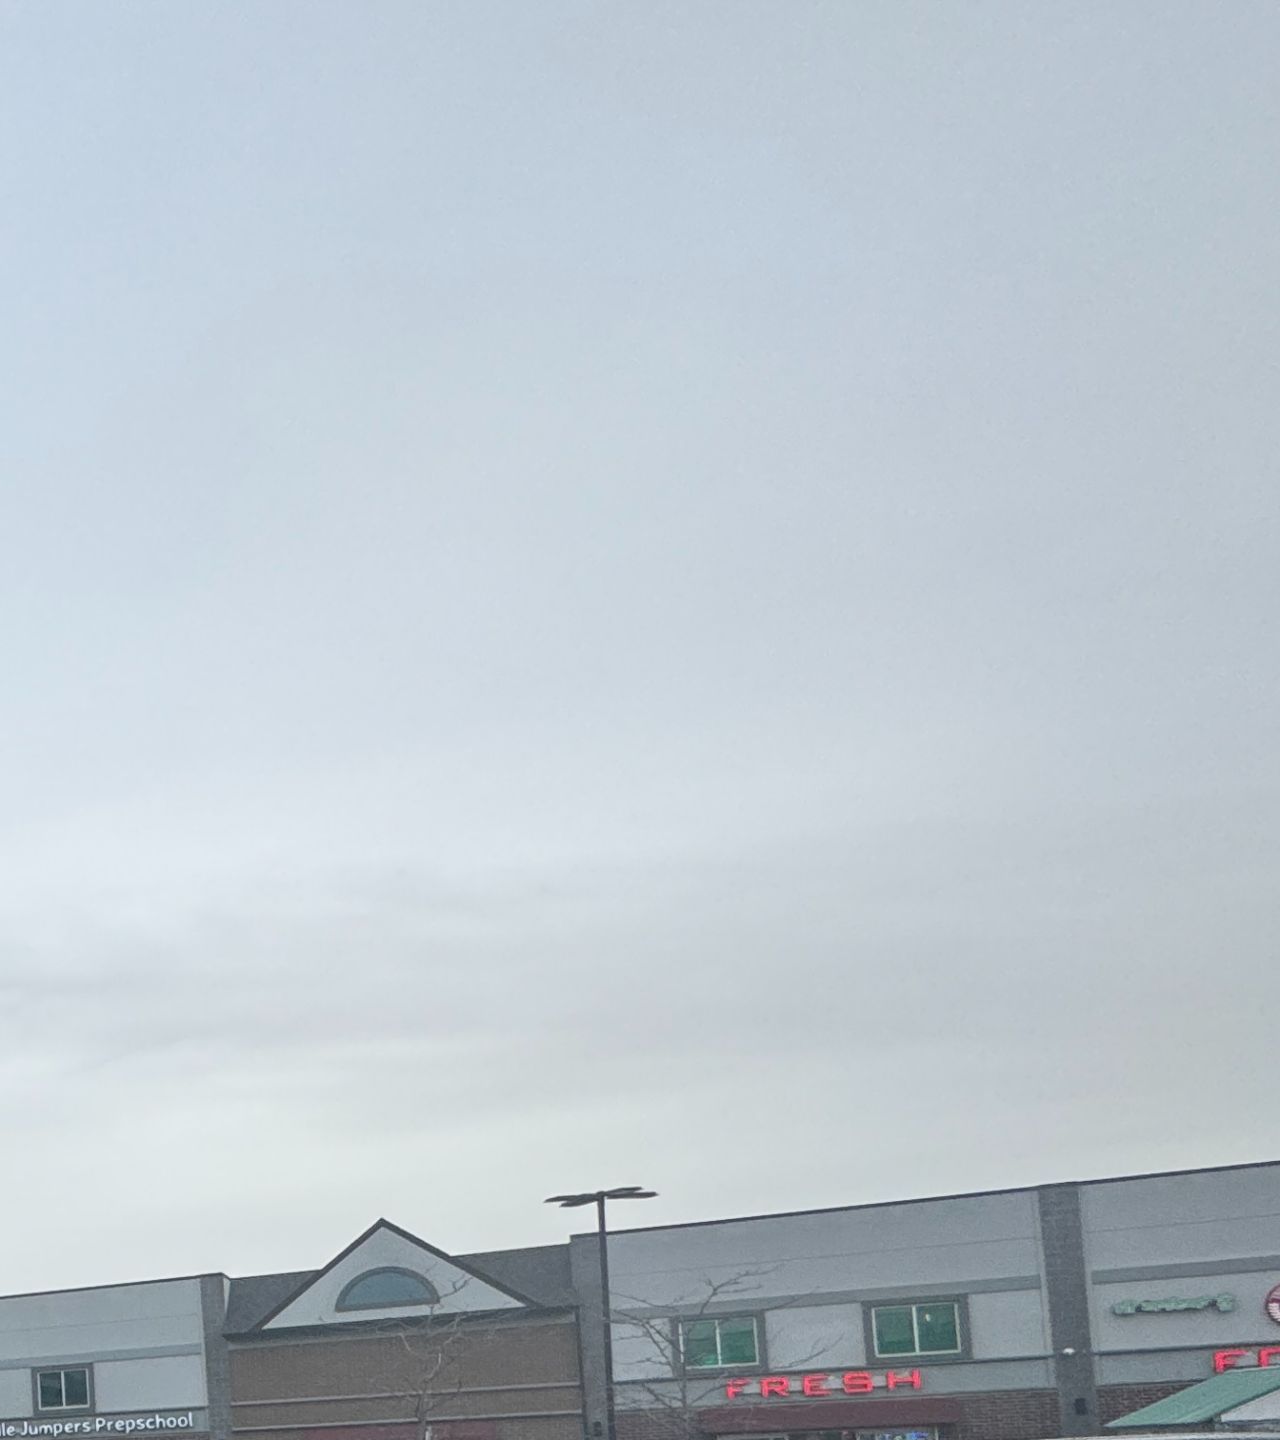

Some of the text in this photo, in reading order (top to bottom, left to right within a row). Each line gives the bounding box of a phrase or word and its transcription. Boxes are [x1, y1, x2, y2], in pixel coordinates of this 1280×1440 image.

[726, 1368, 922, 1399] FRESH
[20, 1421, 91, 1437] Jumpers
[95, 1411, 193, 1434] Prepschool
